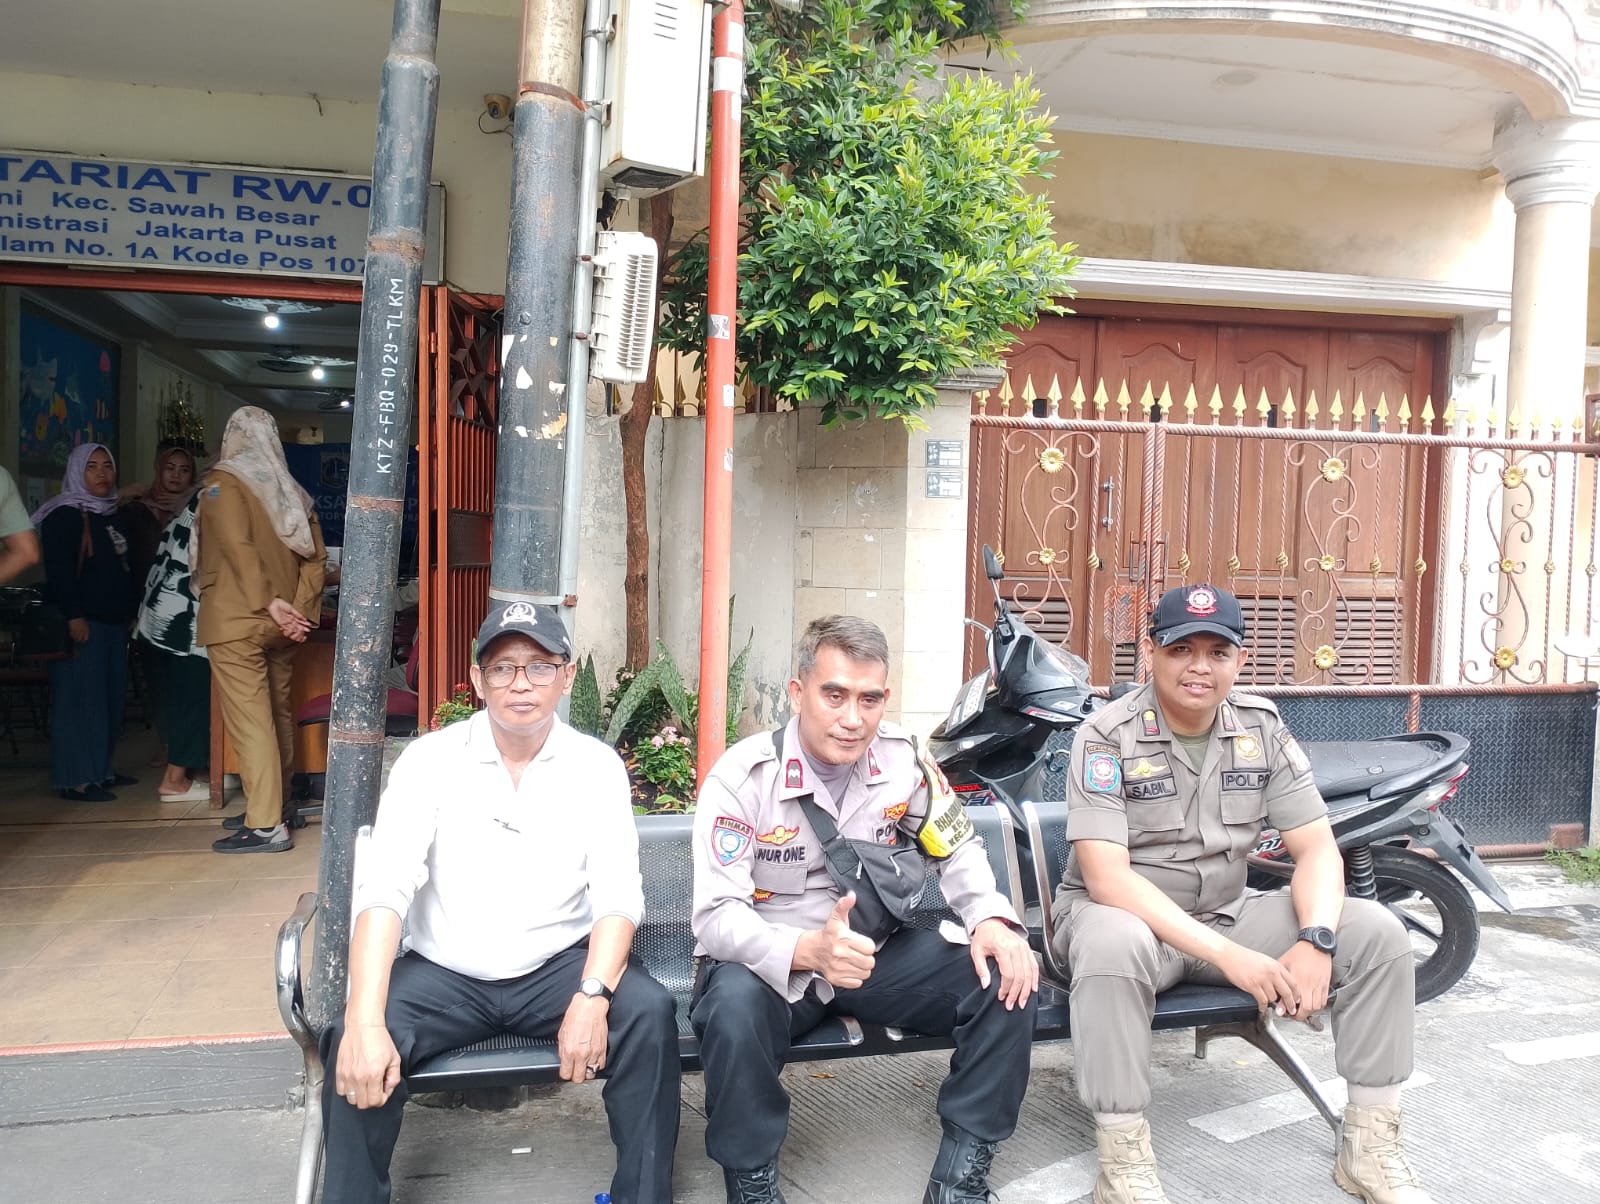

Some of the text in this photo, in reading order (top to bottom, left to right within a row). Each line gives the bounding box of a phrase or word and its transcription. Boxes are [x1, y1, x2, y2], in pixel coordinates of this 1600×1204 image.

[0, 157, 211, 194] TARIAT
[52, 191, 117, 211] Kec.
[127, 196, 225, 219] Sawah
[236, 205, 320, 226] Besar
[0, 212, 337, 250] nistrasi Jakarta Pusat
[65, 237, 113, 256] No.
[125, 242, 158, 259] 1A
[173, 245, 249, 266] Kode
[260, 251, 313, 270] Pos
[1131, 782, 1172, 797] SABIL
[1225, 774, 1256, 787] POL
[783, 846, 806, 862] ONE
